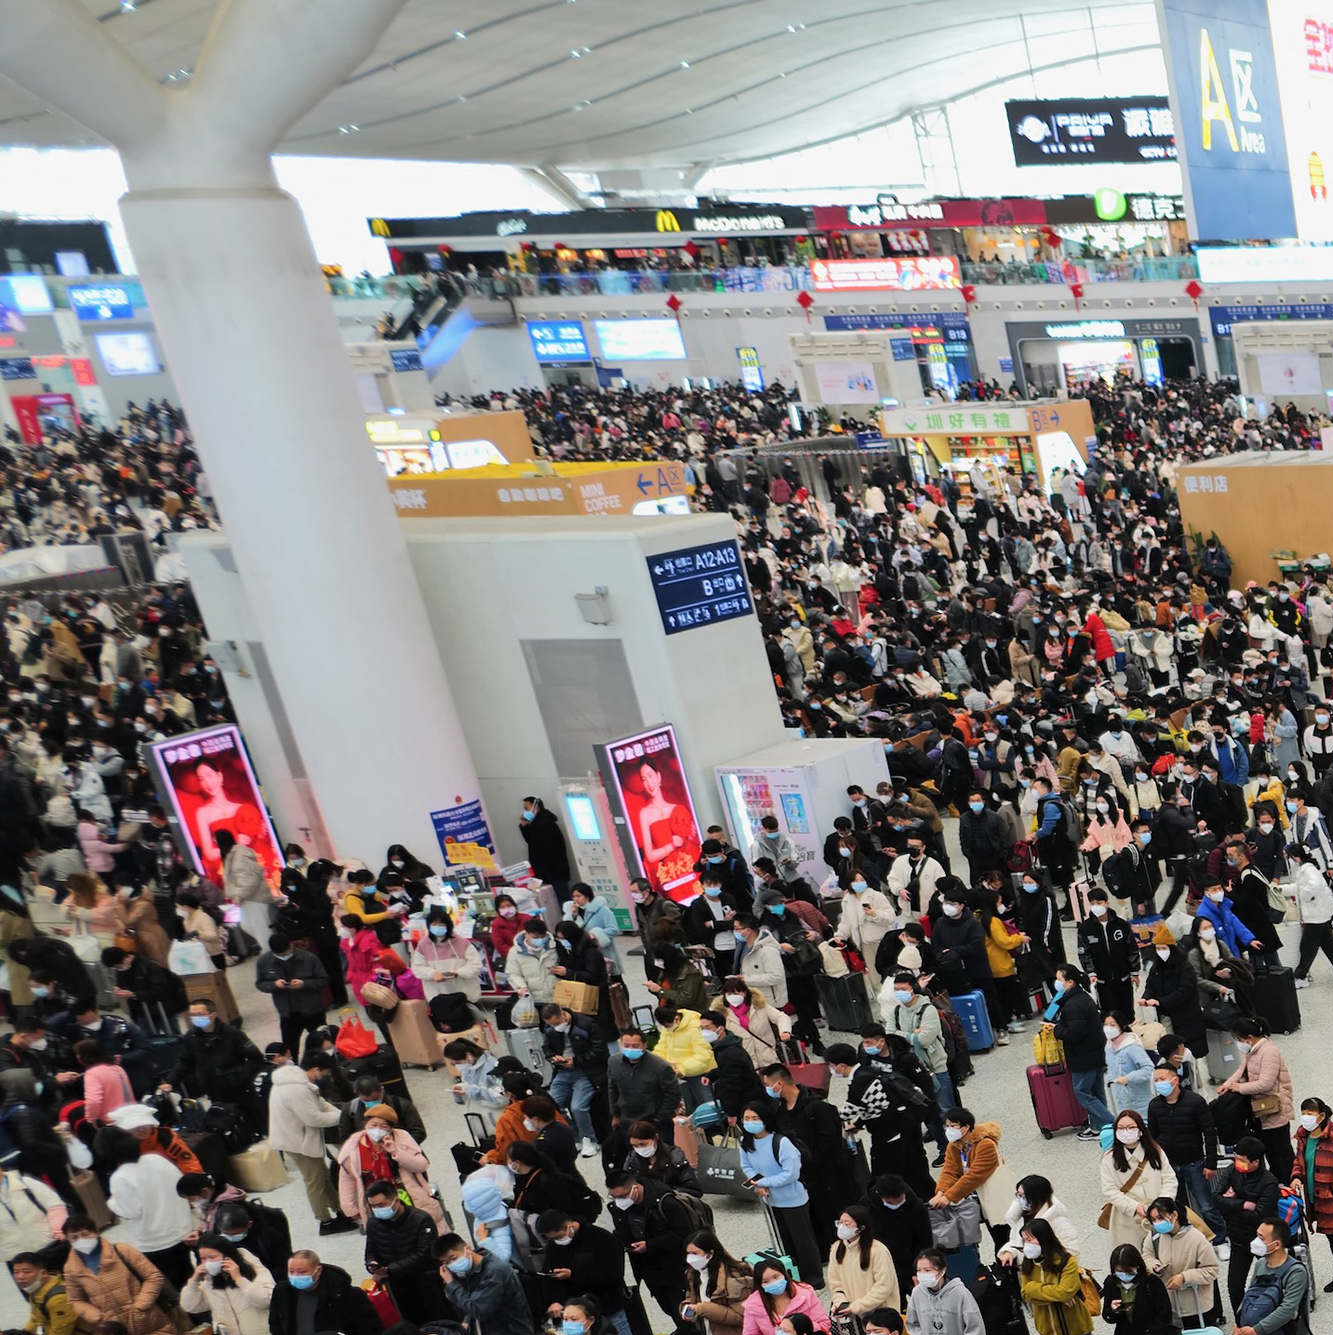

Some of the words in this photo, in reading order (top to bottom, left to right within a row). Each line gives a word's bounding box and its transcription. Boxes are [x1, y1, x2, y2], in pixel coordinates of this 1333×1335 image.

[1240, 125, 1266, 154] Area
[693, 214, 785, 232] McDonald's
[580, 483, 606, 499] MINI
[1184, 475, 1228, 493] 便利店
[584, 495, 623, 513] COFFEE
[702, 579, 714, 597] B
